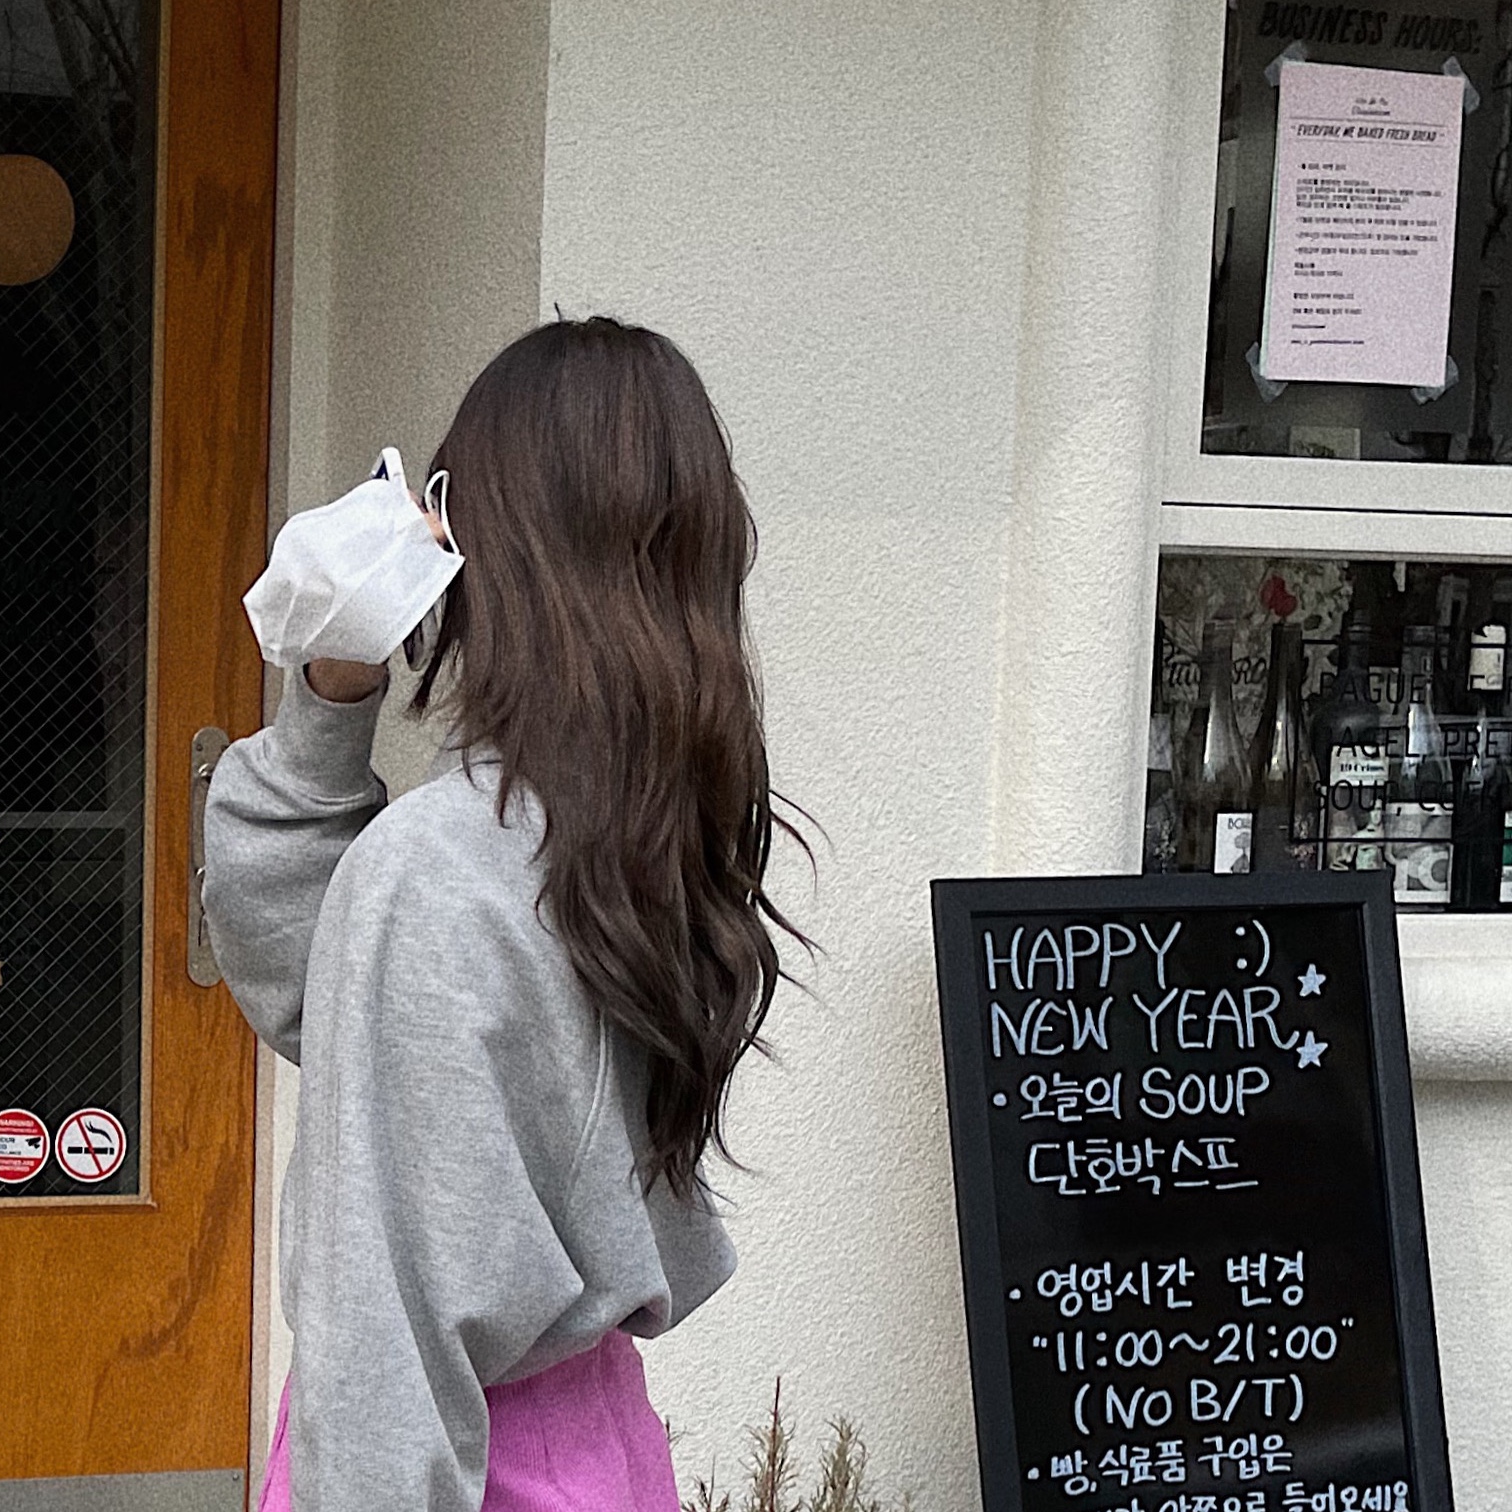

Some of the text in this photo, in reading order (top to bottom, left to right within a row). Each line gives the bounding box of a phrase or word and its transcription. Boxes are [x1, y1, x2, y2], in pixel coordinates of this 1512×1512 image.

[1259, 2, 1389, 45] BUSINESS
[985, 920, 1182, 991] HAPPY
[991, 986, 1300, 1058] NEW YEAR
[1020, 1066, 1271, 1123] 오늘의 SOUP
[1036, 1250, 1306, 1318] 영업시간 변경
[1198, 1433, 1294, 1481] 구입은
